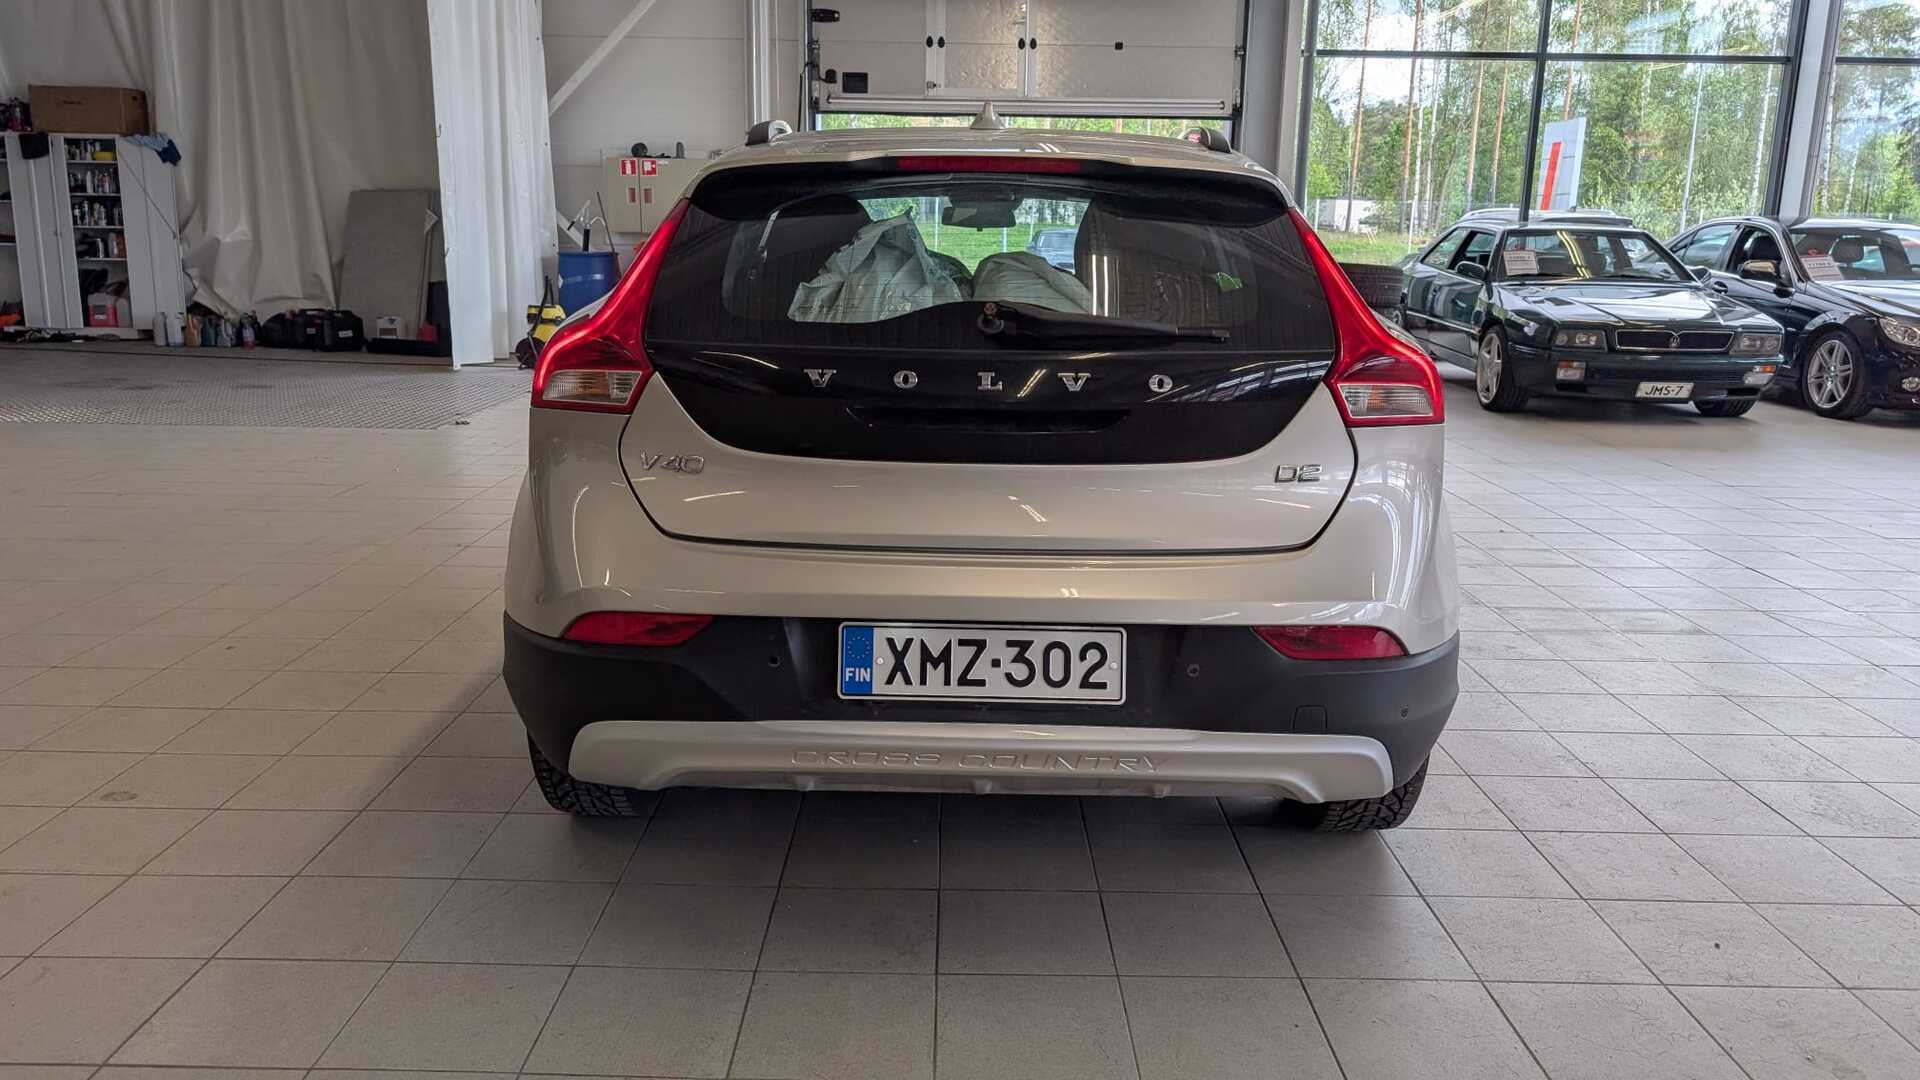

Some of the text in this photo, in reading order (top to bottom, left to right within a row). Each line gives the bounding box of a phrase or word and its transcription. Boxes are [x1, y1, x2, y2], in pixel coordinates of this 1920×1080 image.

[803, 368, 1174, 393] VOLVO
[1645, 385, 1684, 396] JMS-7
[641, 452, 704, 473] V40
[1274, 464, 1322, 483] D2
[884, 637, 1109, 690] XMZ-302
[844, 667, 871, 683] FIN
[791, 751, 1173, 773] CROSS COUNTRY
